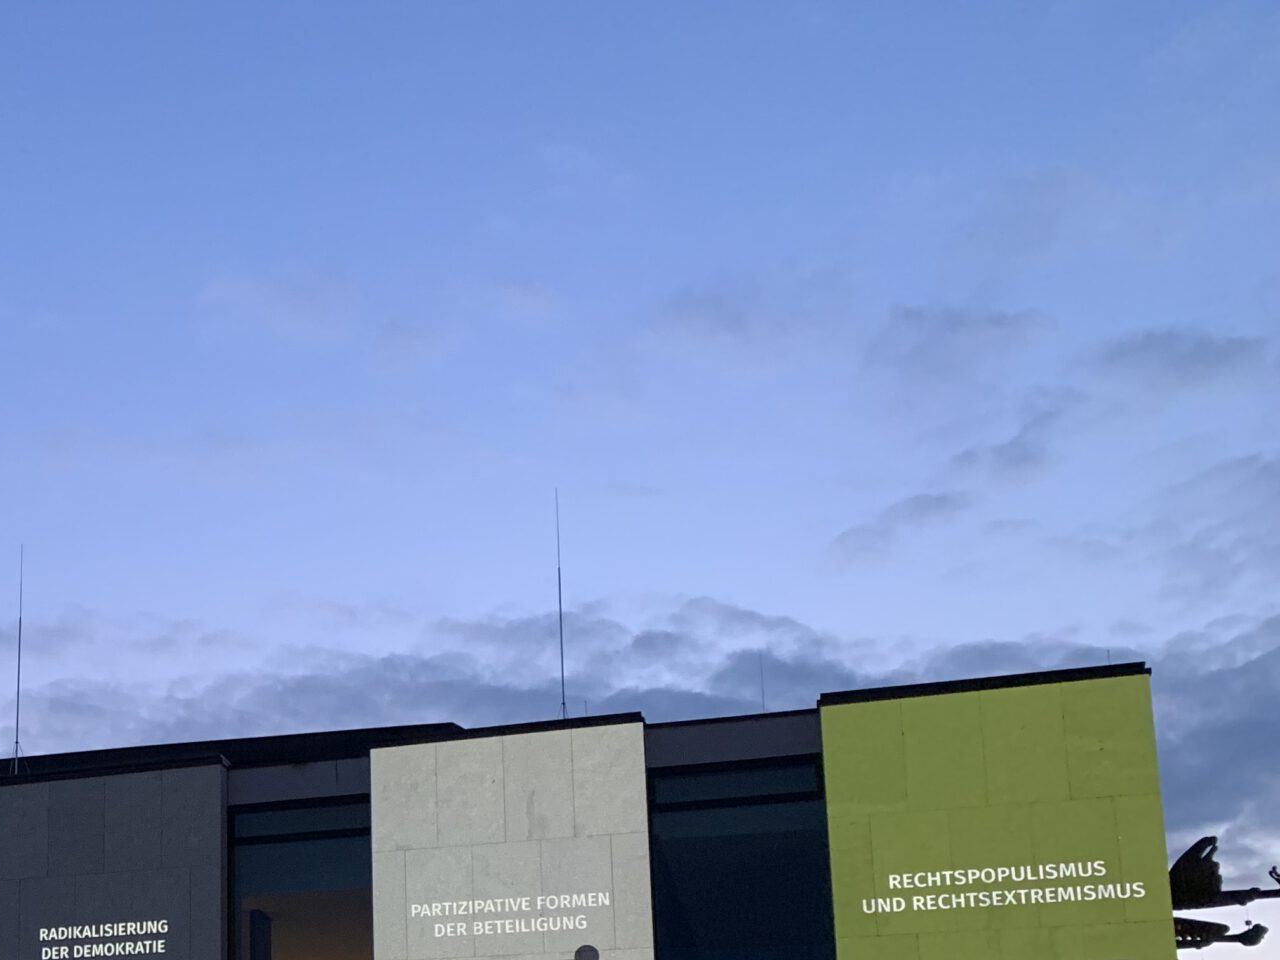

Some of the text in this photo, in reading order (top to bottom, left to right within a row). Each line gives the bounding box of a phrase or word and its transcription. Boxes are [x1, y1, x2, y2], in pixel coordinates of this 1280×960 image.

[888, 860, 1107, 889] RECHTSPOPULISMUS
[411, 892, 610, 917] PARTIZIPATIVE FORMEN
[862, 881, 1146, 914] UND RECHTSEXTREMISMUS
[39, 920, 168, 941] RADIKALISIERUNG
[434, 914, 587, 937] DER BETEILIGUNG
[41, 939, 166, 960] DER DEMOKRATIE
